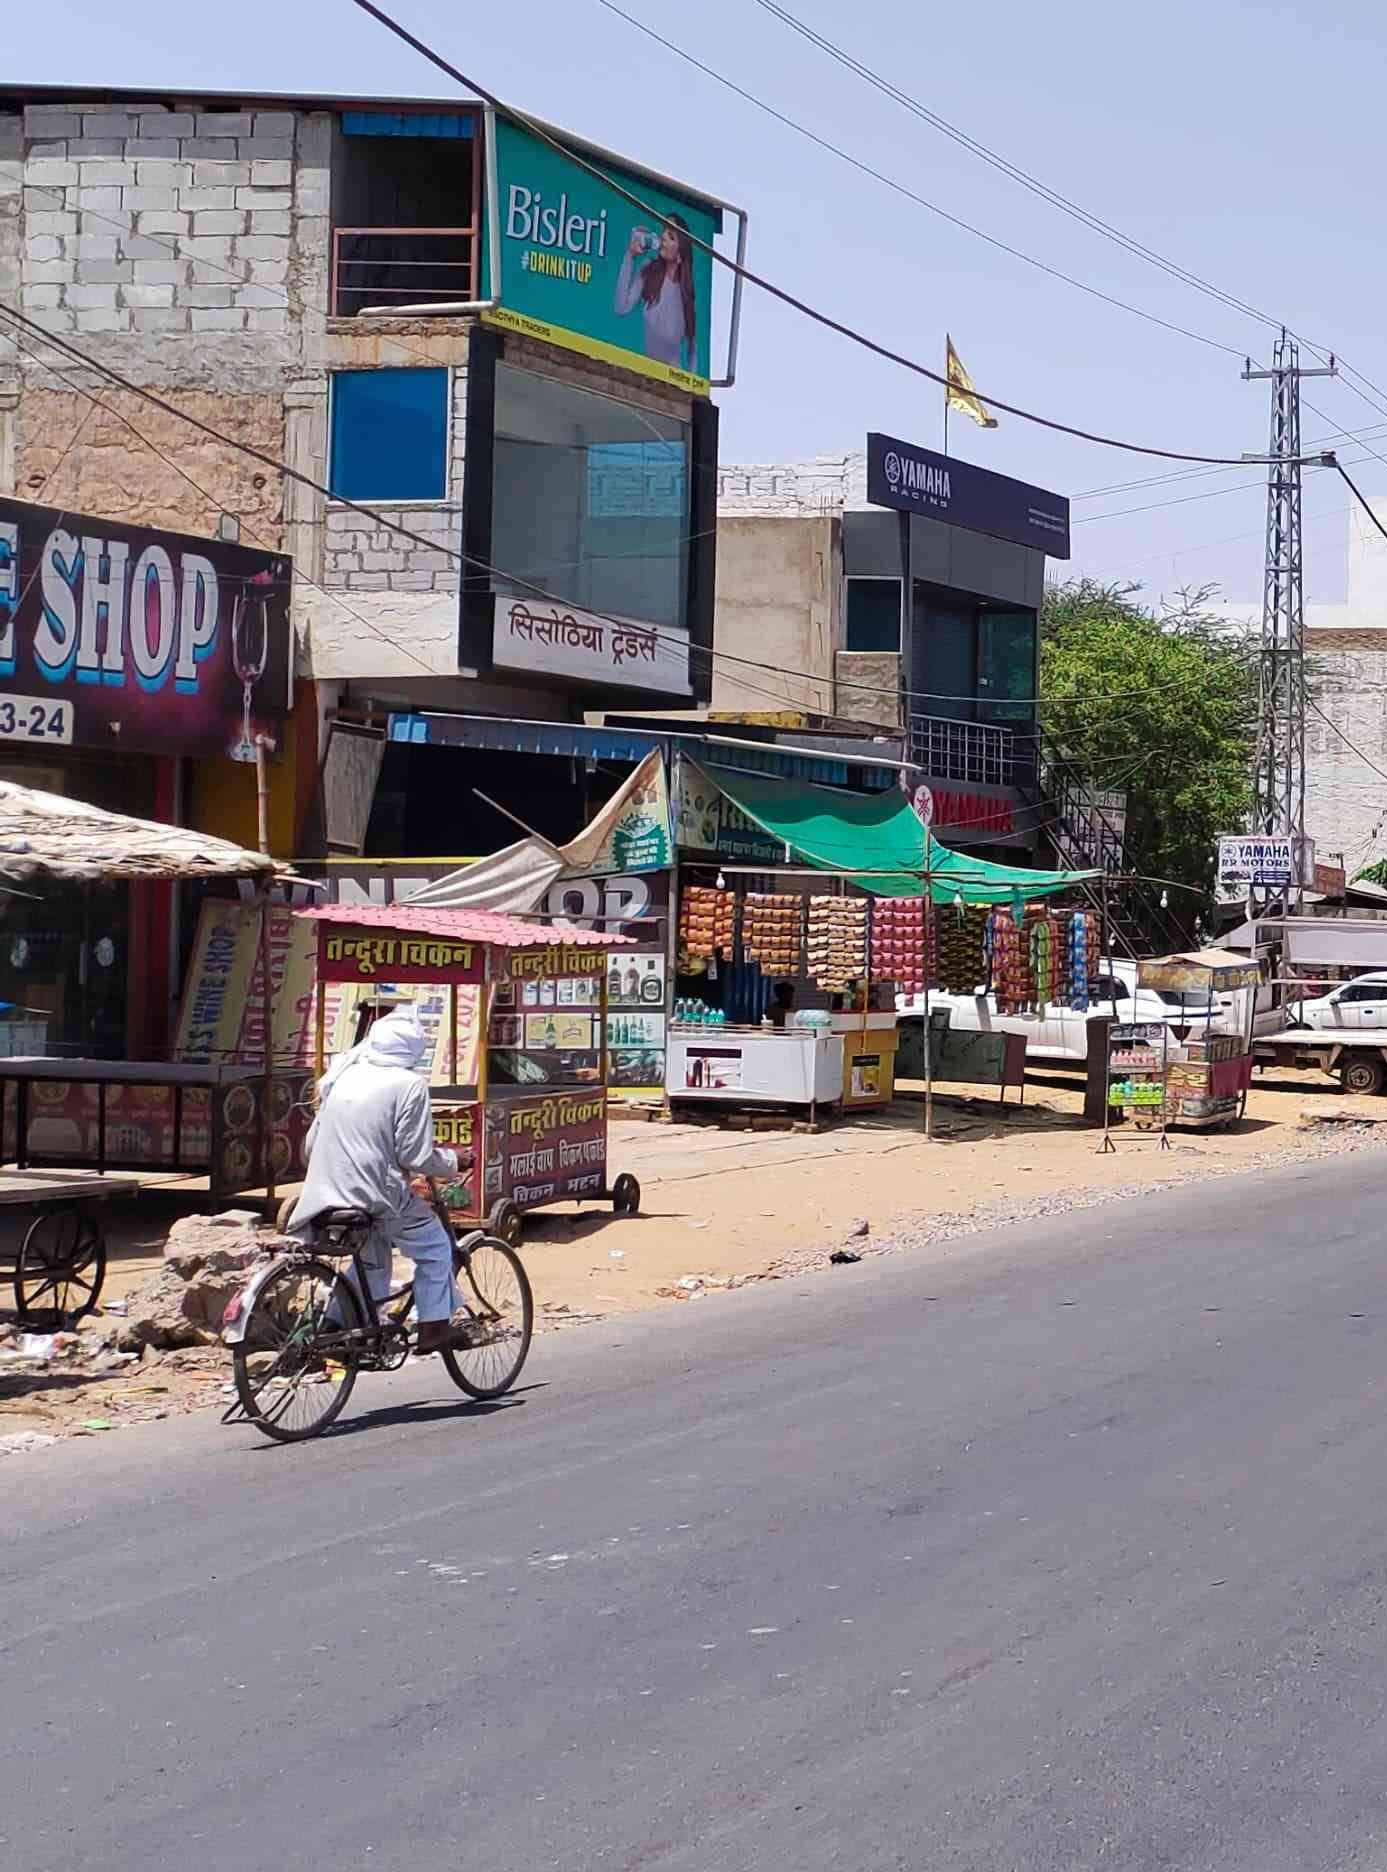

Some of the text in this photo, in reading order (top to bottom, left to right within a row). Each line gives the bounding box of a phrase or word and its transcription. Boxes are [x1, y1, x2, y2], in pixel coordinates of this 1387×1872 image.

[506, 184, 607, 257] Bisleri
[521, 251, 592, 283] #DRINKITUP
[901, 457, 950, 498] YAMAHA
[33, 528, 219, 693] SHOP
[1239, 845, 1290, 858] YAMAHA
[1242, 859, 1290, 867] MOTORS
